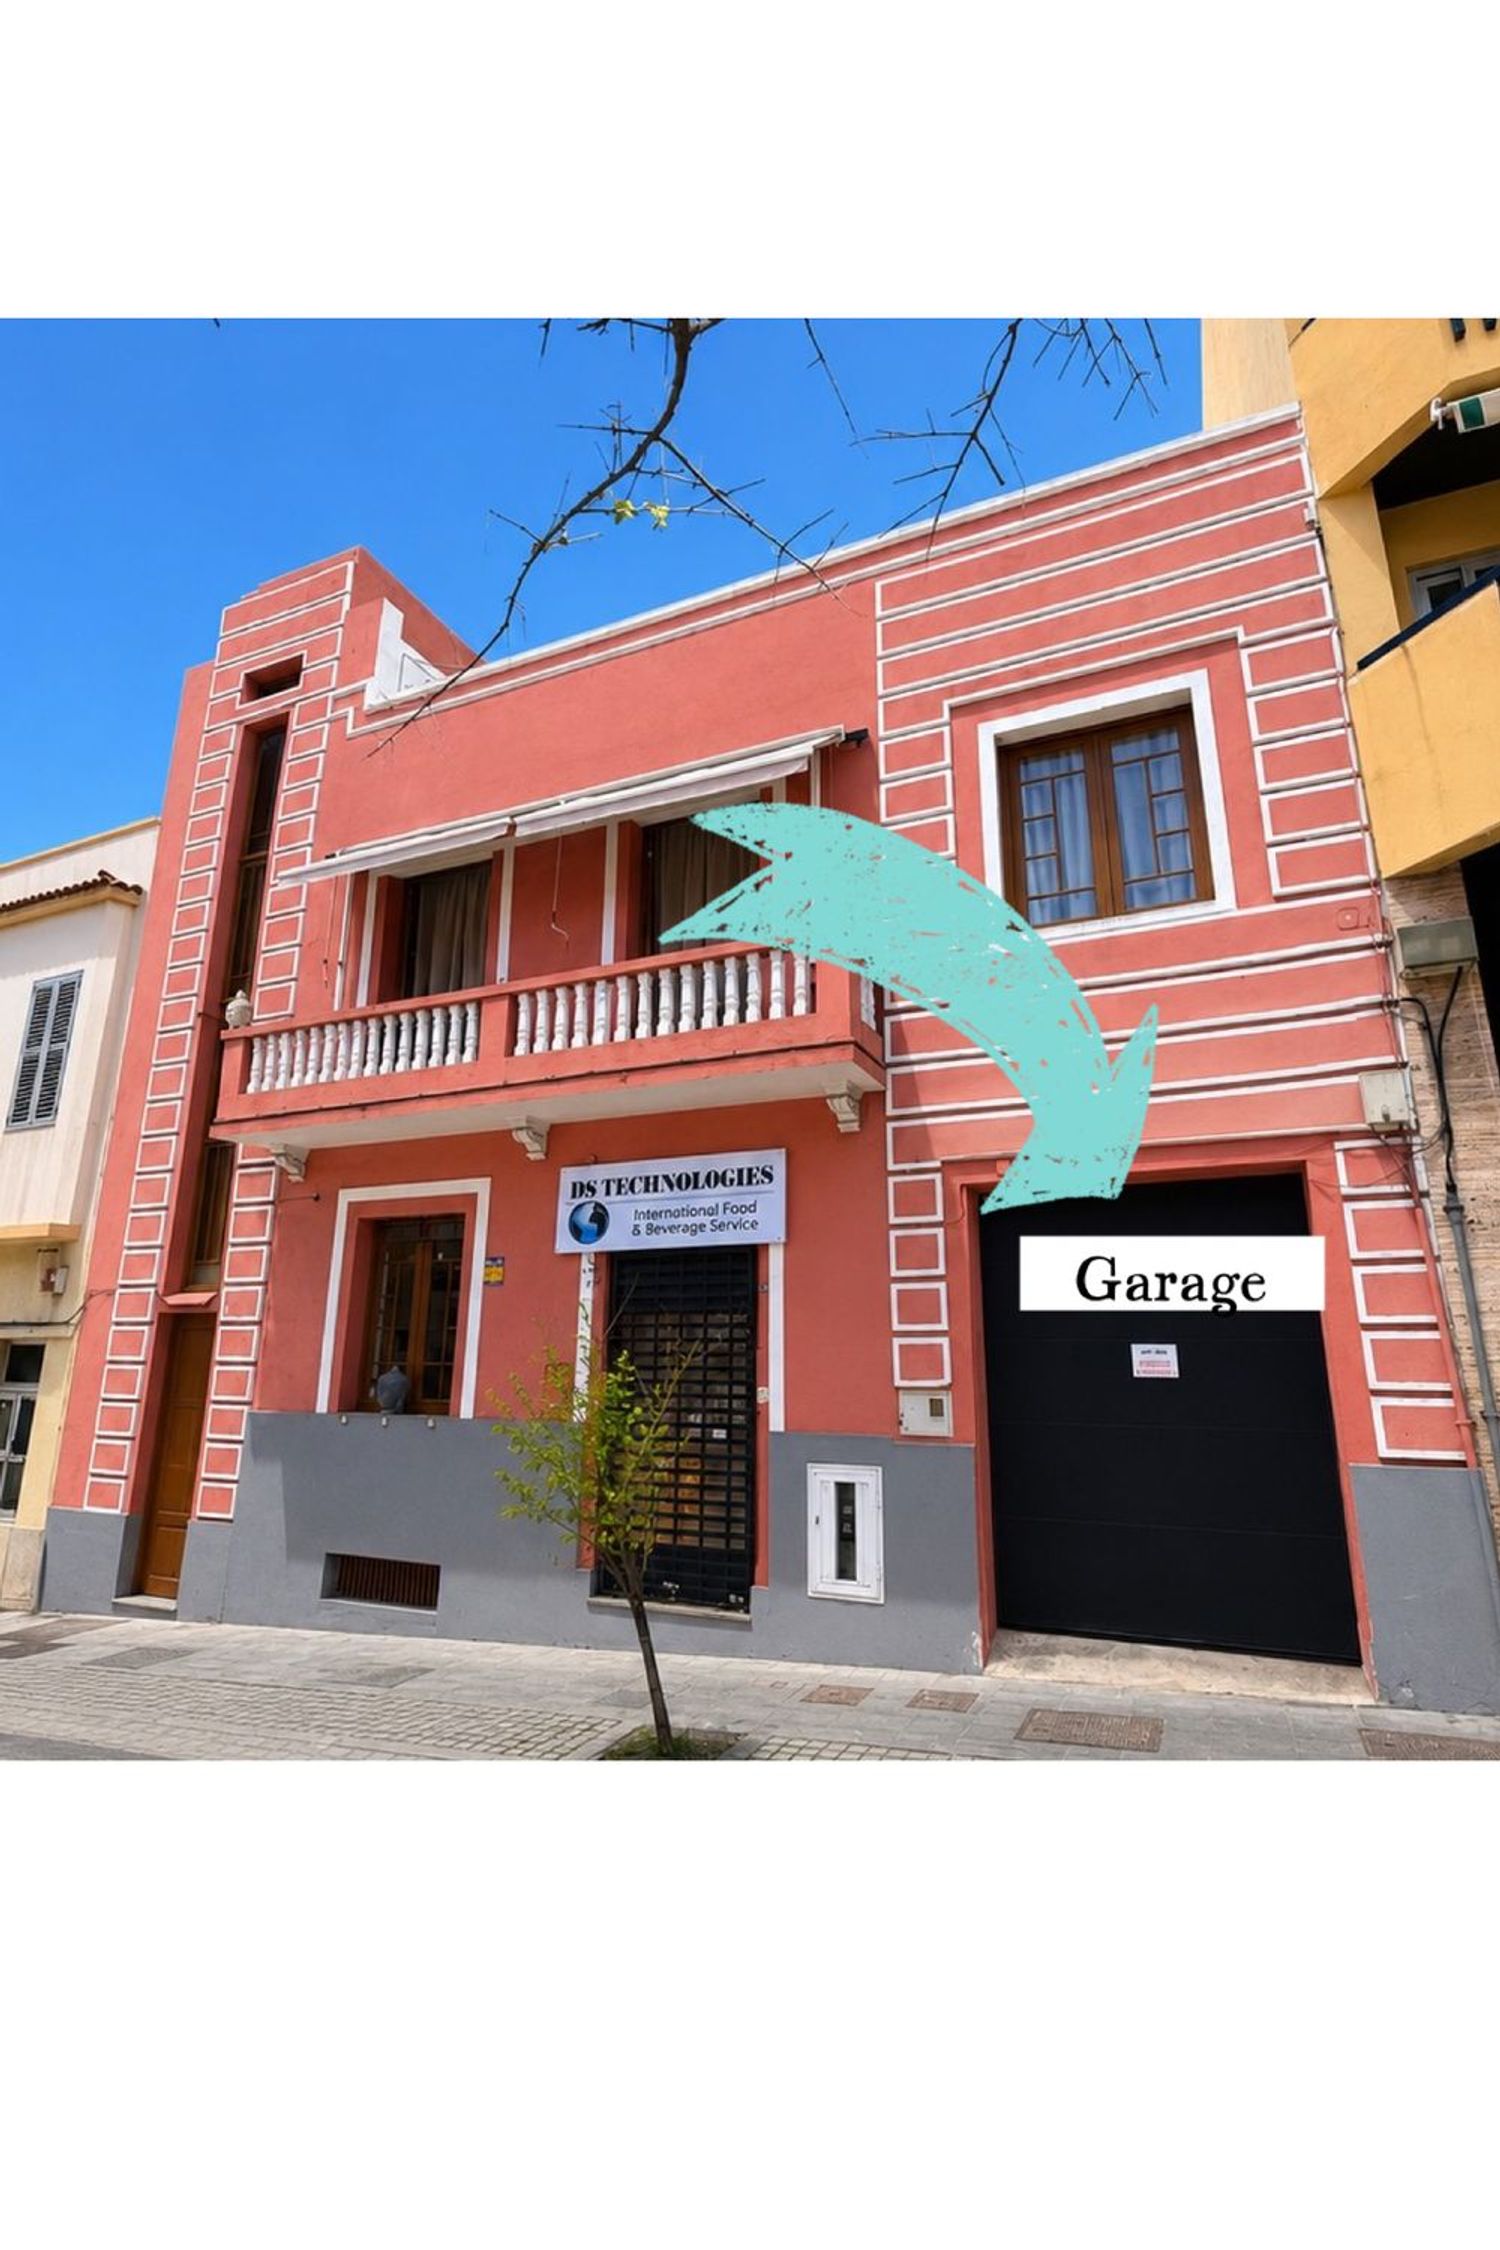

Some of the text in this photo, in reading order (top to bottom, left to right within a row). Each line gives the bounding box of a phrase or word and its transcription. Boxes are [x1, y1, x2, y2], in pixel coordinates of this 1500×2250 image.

[570, 1165, 774, 1199] DS TECHNOLOGIES
[634, 1200, 758, 1221] International Food
[631, 1217, 759, 1237] & Beverage Service
